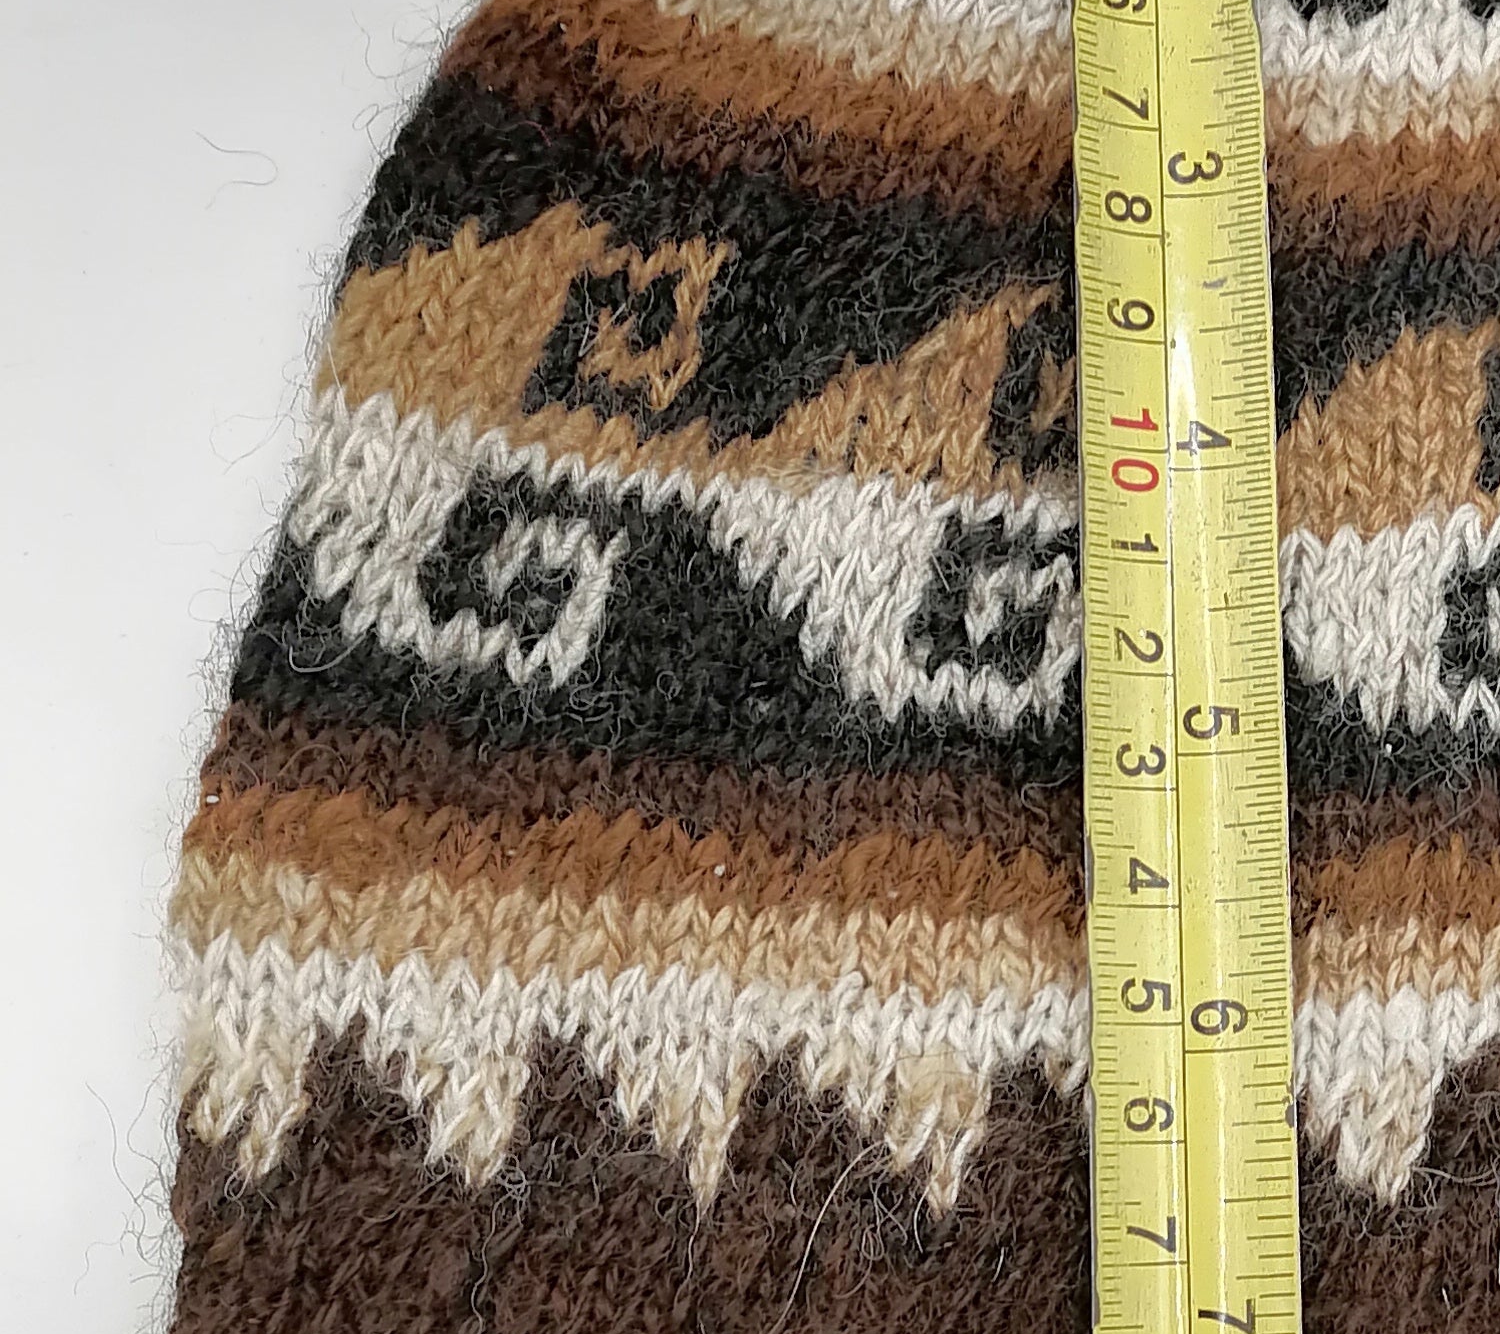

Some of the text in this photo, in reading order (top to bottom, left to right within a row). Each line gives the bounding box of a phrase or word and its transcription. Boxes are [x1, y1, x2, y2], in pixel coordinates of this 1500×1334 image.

[1102, 87, 1149, 121] 7
[1168, 151, 1223, 185] 3
[1105, 190, 1152, 224] 8
[1107, 298, 1155, 332] 9
[1111, 408, 1159, 492] 10
[1177, 420, 1232, 457] 4
[1111, 532, 1159, 553] 1
[1114, 627, 1164, 663] 2
[1182, 705, 1240, 740] 5
[1116, 743, 1167, 777] 3
[1127, 857, 1170, 895] 4
[1121, 978, 1172, 1012] 5
[1190, 999, 1248, 1035] 6
[1123, 1097, 1174, 1132] 6
[1126, 1216, 1176, 1253] 7
[1198, 1298, 1256, 1334] 7
